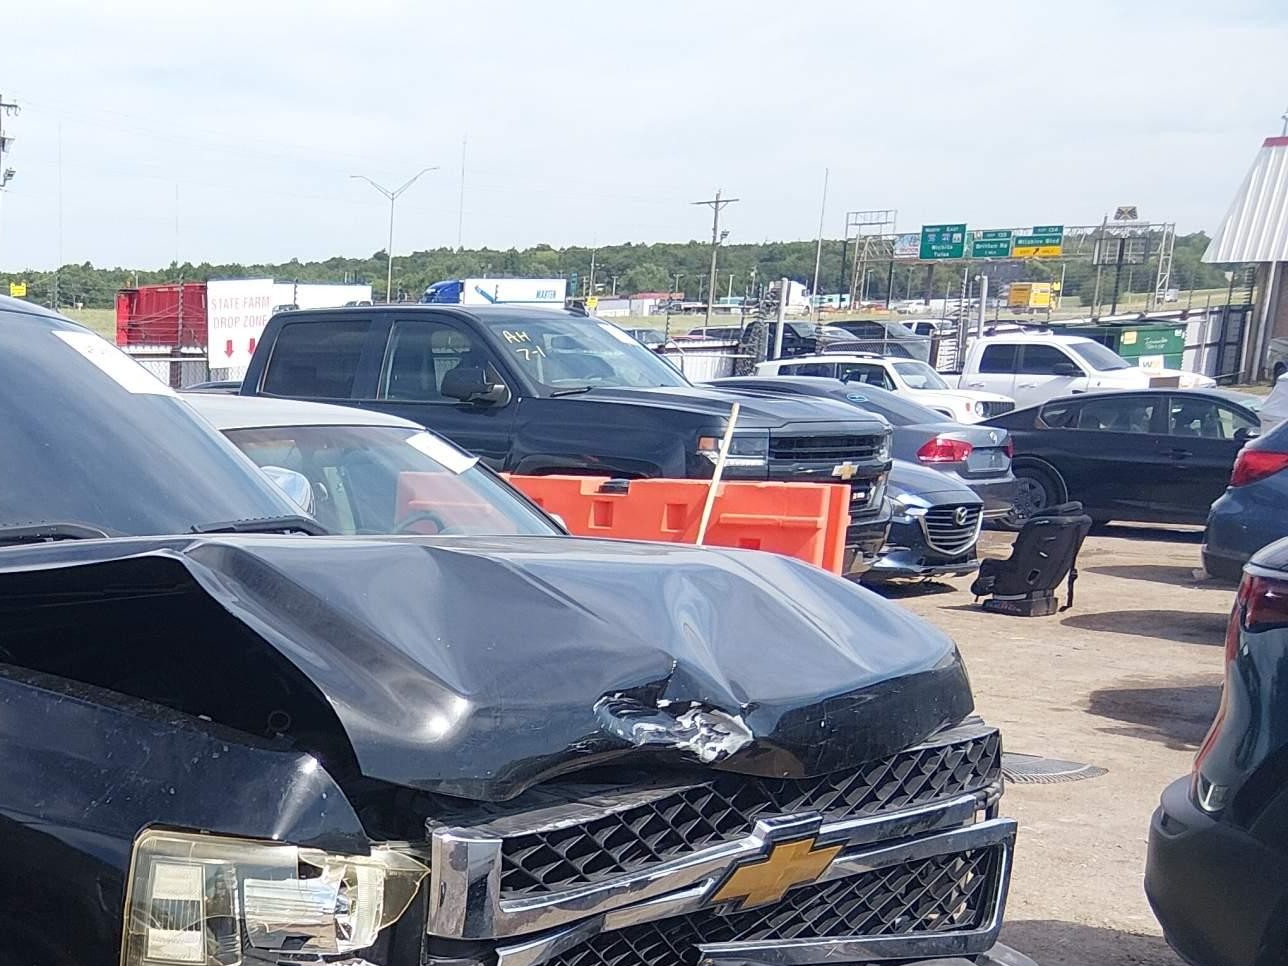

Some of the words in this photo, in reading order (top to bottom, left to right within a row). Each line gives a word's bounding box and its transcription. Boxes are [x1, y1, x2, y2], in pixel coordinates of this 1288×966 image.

[211, 297, 239, 309] STATE
[242, 295, 271, 308] FARM
[213, 316, 240, 329] DROP
[243, 314, 268, 328] ZONE
[502, 330, 531, 344] AH
[515, 345, 546, 361] 7-1
